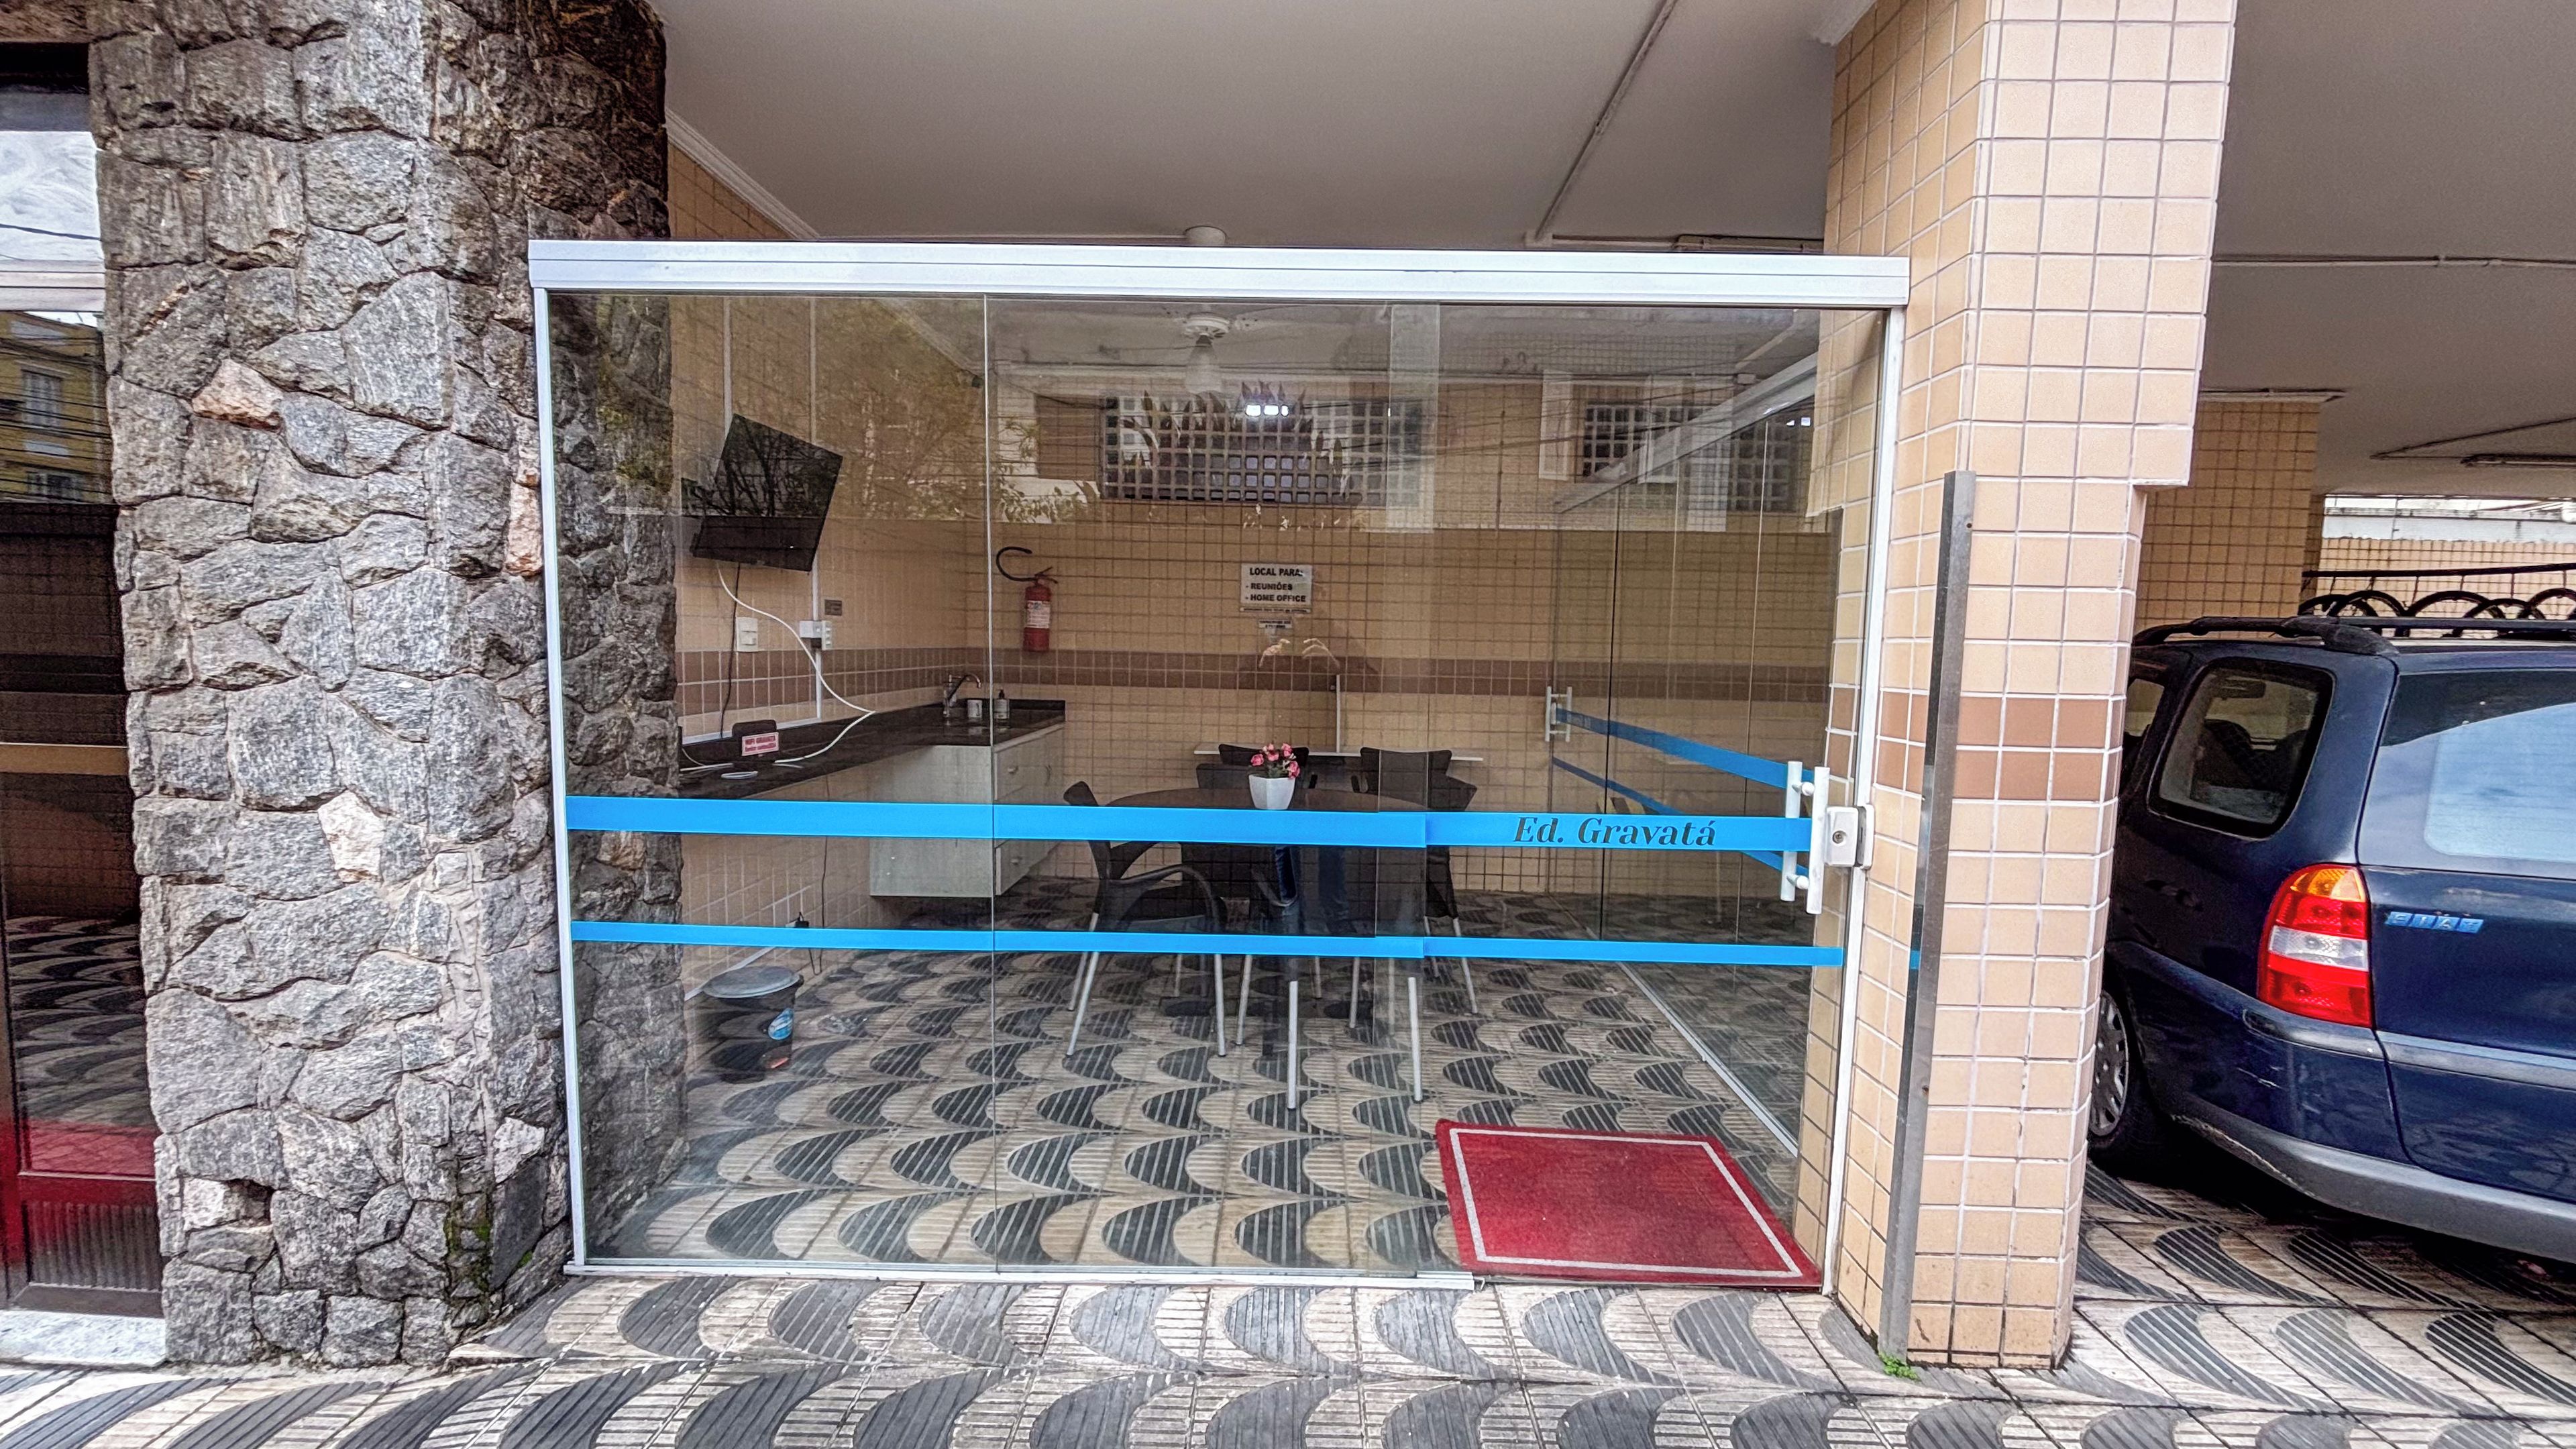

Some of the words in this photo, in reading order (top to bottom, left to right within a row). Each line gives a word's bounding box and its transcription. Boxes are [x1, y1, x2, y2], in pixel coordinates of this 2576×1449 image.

[1250, 568, 1276, 576] LOCAL
[1250, 594, 1275, 602] HOME
[1277, 594, 1306, 602] OFFICE
[1513, 816, 1564, 843] Ed.
[1578, 817, 1717, 847] Gravatá
[2389, 912, 2482, 932] FIAT
